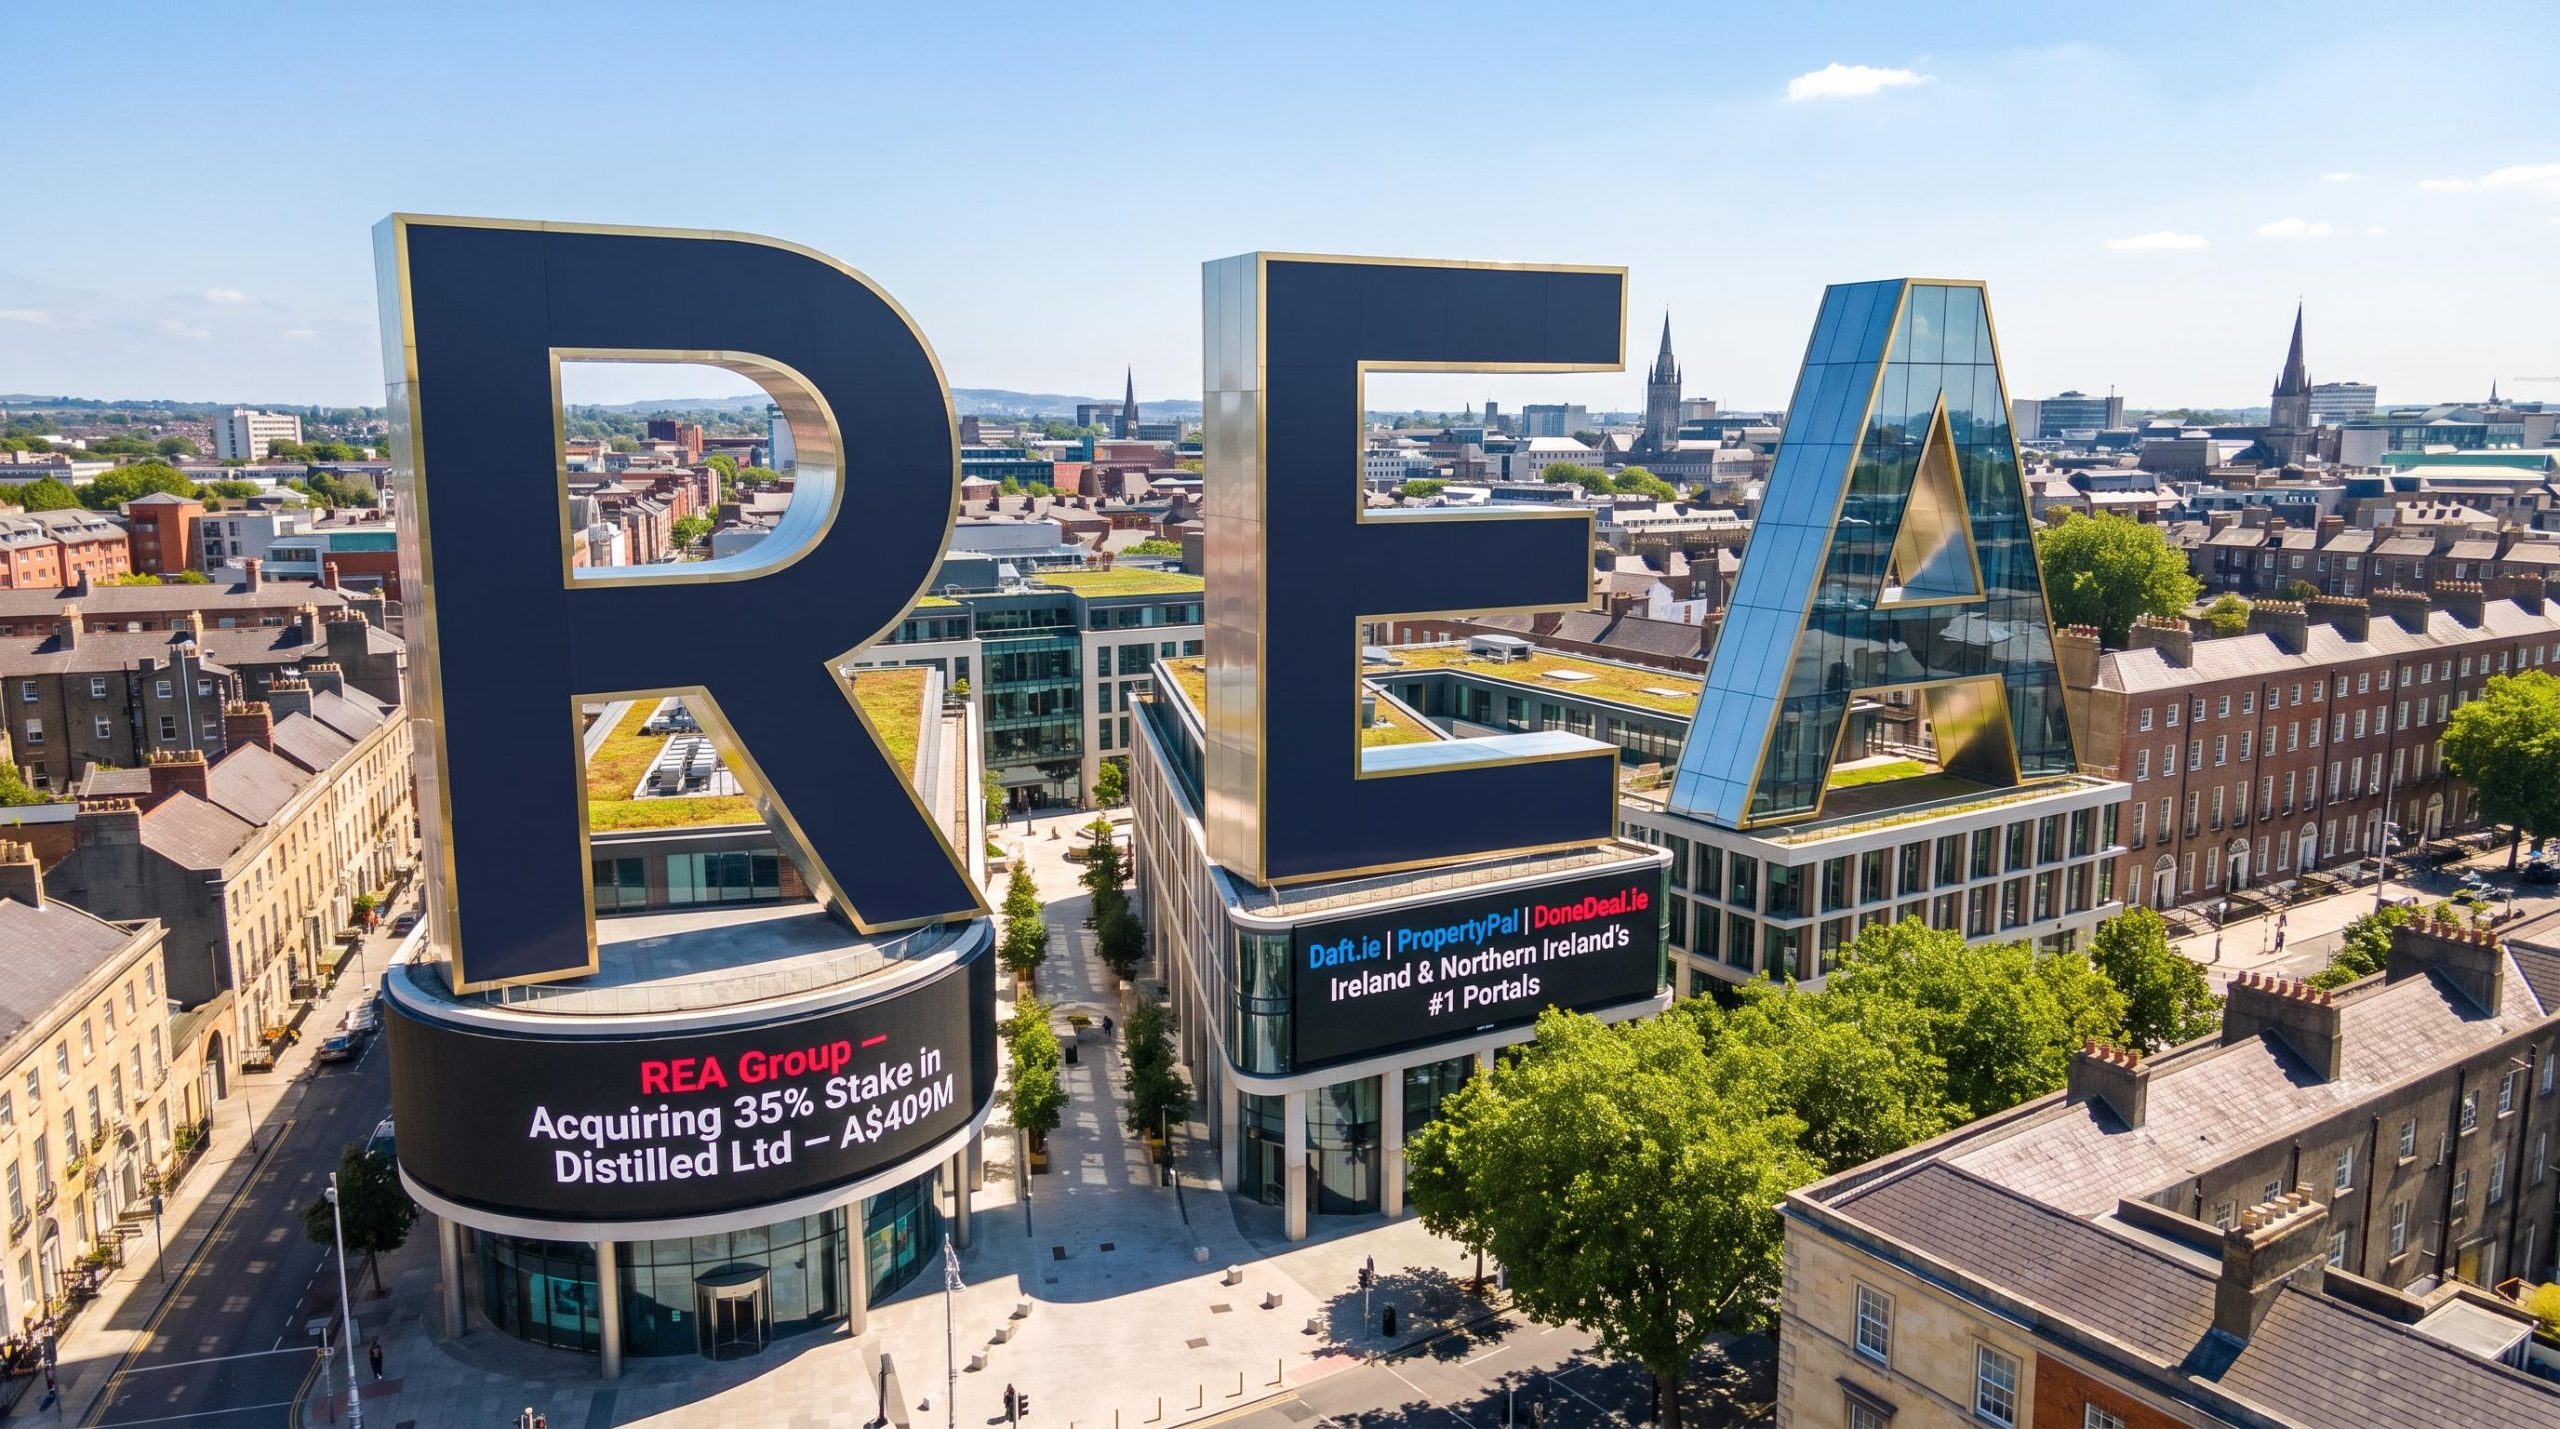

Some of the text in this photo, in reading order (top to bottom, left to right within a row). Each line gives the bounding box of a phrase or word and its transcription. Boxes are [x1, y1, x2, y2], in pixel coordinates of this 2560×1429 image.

[1309, 935, 1381, 969] Daft.ie
[1398, 908, 1519, 953] PropertyPal
[1534, 886, 1649, 929] DoneDeal.ie
[1331, 962, 1411, 1001] Ireland
[1417, 960, 1435, 985] &
[1440, 943, 1537, 981] Northern
[1428, 972, 1541, 1017] #1 Portals
[528, 1046, 942, 1149] Acquiring 35% Stake in
[640, 1056, 728, 1095] REA
[738, 1040, 852, 1084] Group
[555, 1141, 719, 1184] Distilled
[731, 1129, 792, 1173] Ltd
[840, 1072, 954, 1150] A$409M
